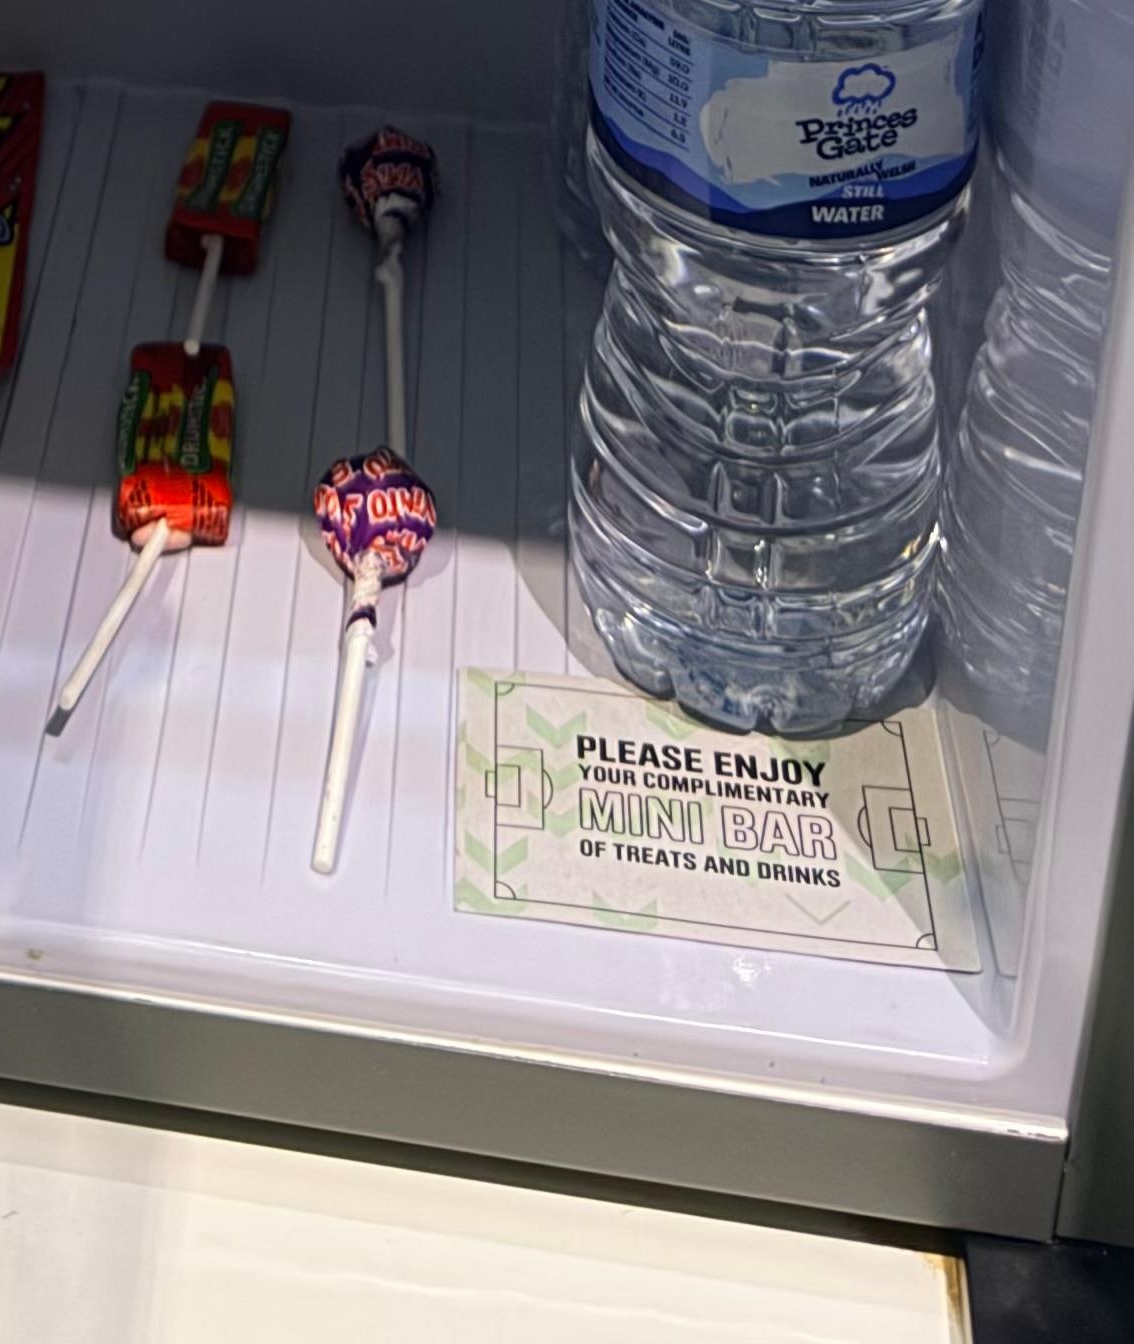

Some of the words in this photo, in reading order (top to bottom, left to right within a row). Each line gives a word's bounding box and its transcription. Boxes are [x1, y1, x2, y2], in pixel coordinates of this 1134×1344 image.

[795, 108, 918, 144] Princes
[817, 128, 898, 160] Gate
[809, 159, 884, 187] NATURALLY
[875, 160, 916, 181] WELSH
[842, 184, 884, 199] STILL
[811, 204, 885, 224] WATER
[577, 735, 703, 773] PLEASE
[714, 752, 826, 787] ENJOY
[579, 764, 637, 787] YOUR
[643, 772, 830, 809] COMPLIMENTARY
[579, 788, 703, 845] MINI
[722, 806, 838, 860] BAR
[579, 839, 606, 858] OF
[614, 843, 697, 871] TREATS
[703, 856, 751, 878] AND
[757, 861, 842, 889] DRINKS
